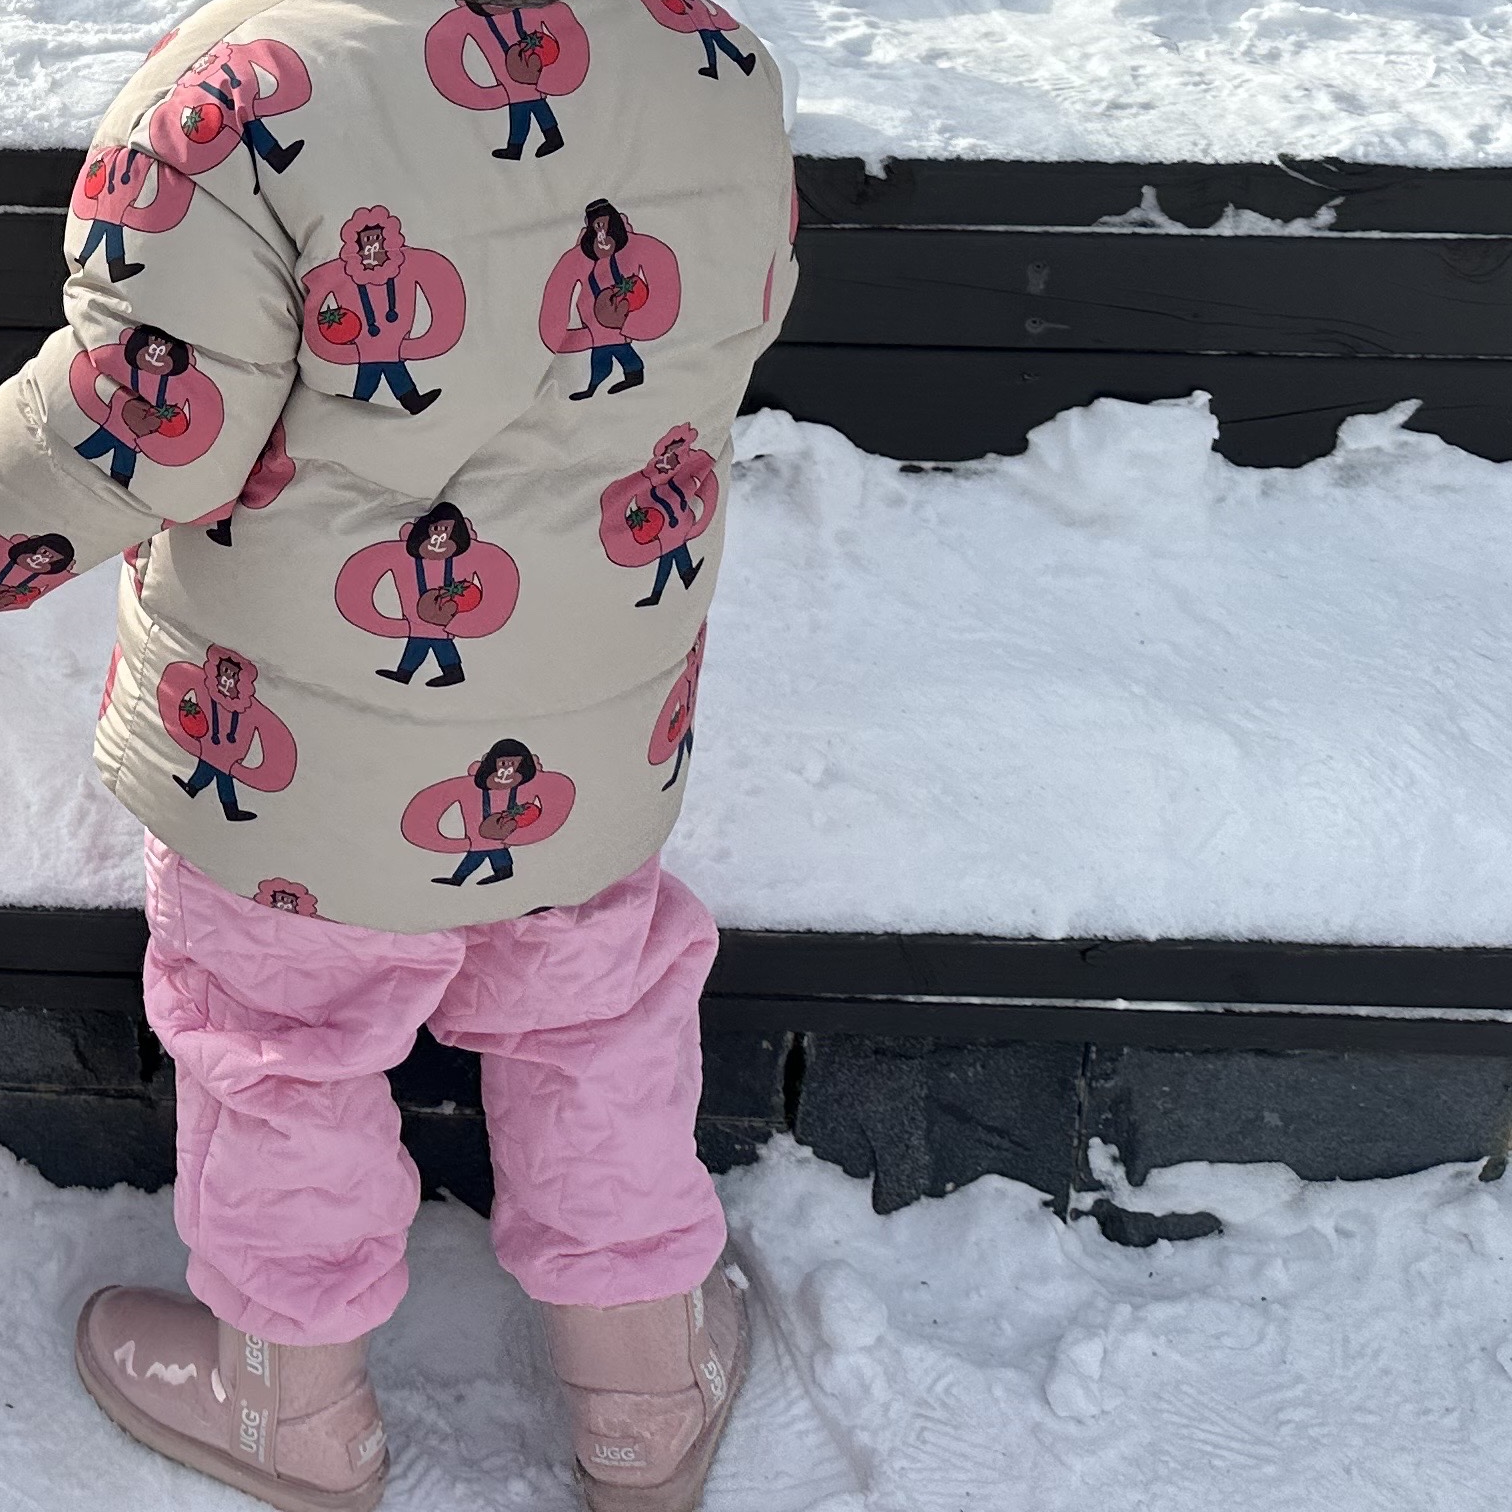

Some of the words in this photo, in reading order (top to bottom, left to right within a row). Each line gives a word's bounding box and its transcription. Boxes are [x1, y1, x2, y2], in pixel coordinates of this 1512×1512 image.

[245, 1333, 263, 1376] UGG
[239, 1407, 260, 1454] UGG
[594, 1443, 636, 1461] UGG
